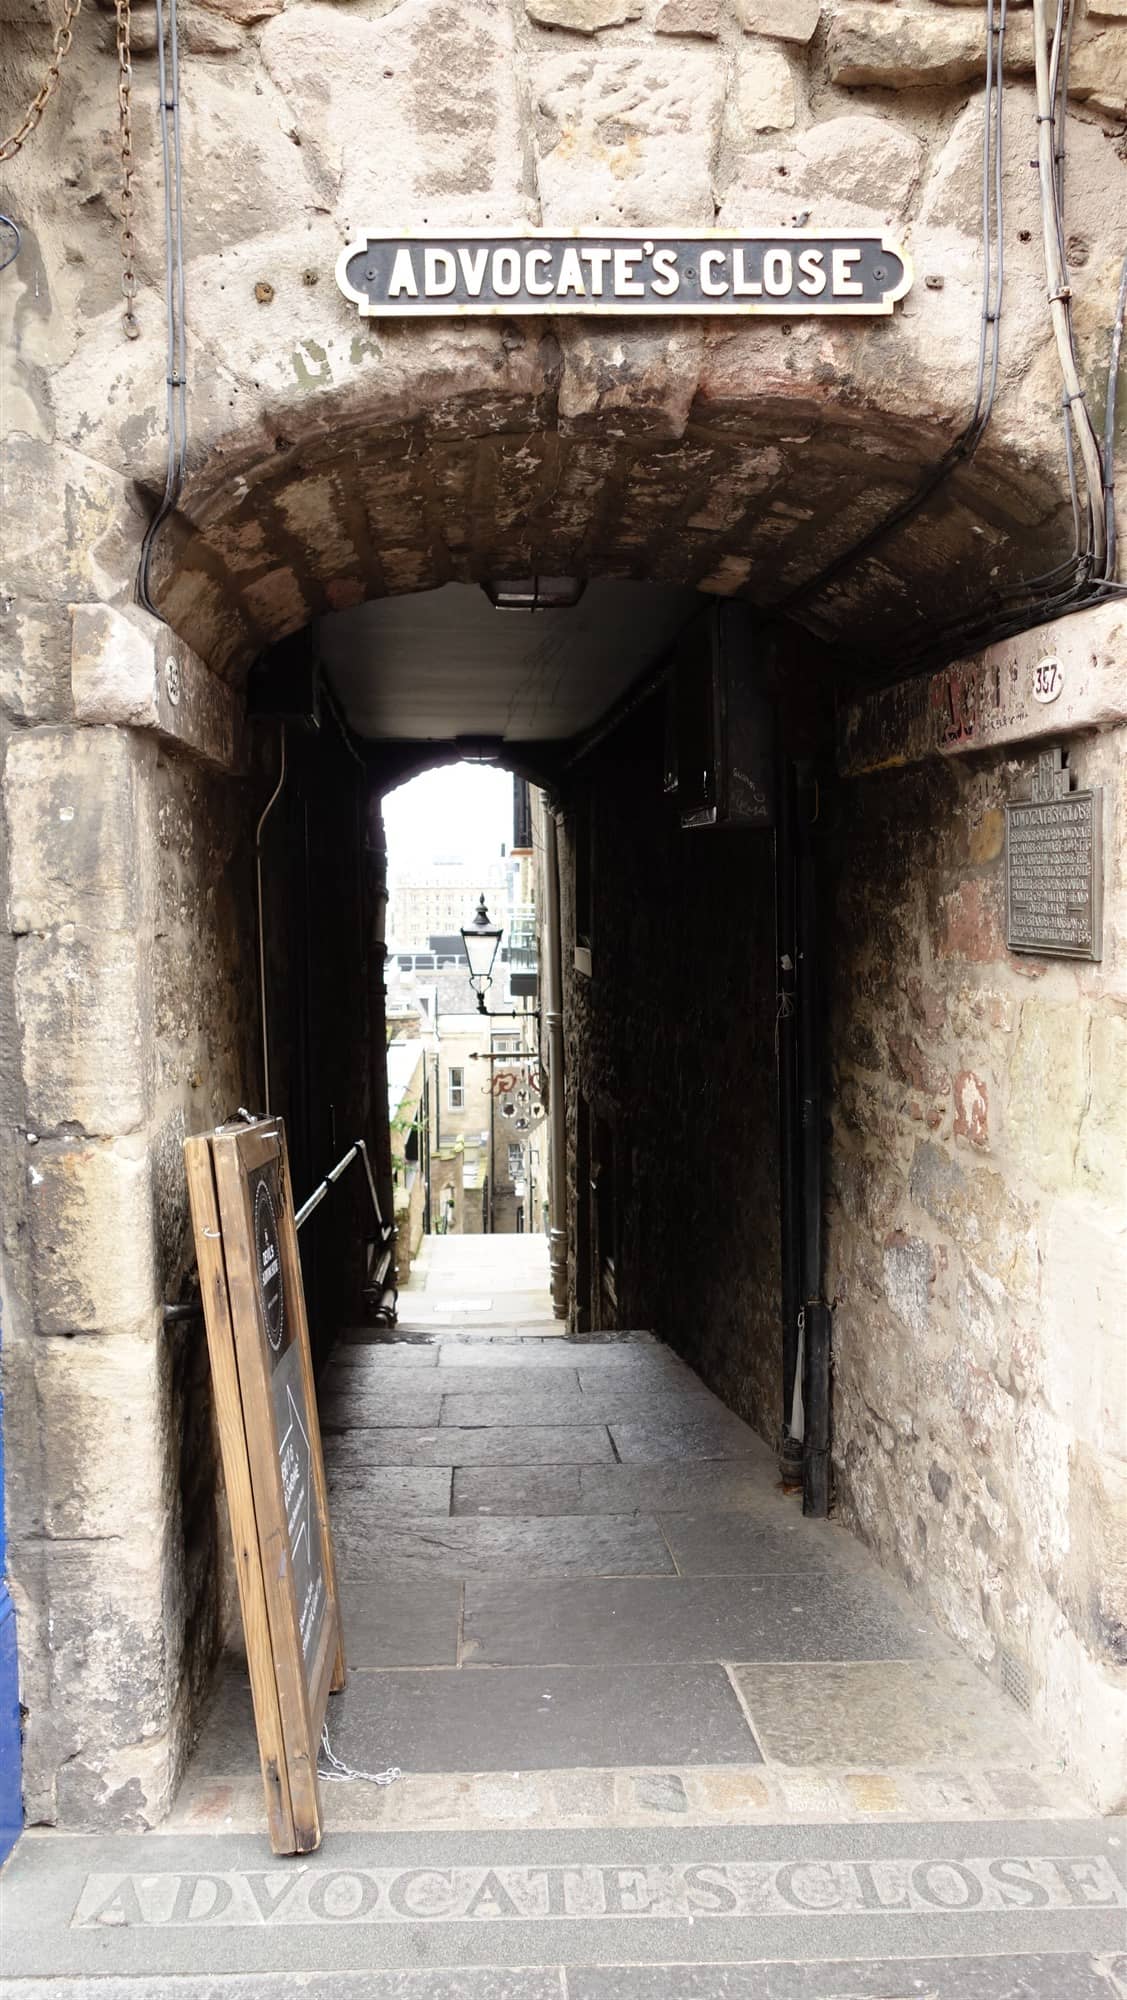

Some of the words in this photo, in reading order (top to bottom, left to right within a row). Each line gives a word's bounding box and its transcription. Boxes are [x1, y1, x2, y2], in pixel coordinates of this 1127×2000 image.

[388, 240, 681, 297] ADVOCATE'S
[701, 247, 864, 297] CLOSE
[1035, 663, 1058, 695] 357
[85, 1863, 738, 1924] ADVOCATE'S
[775, 1857, 1119, 1911] CLOSE
